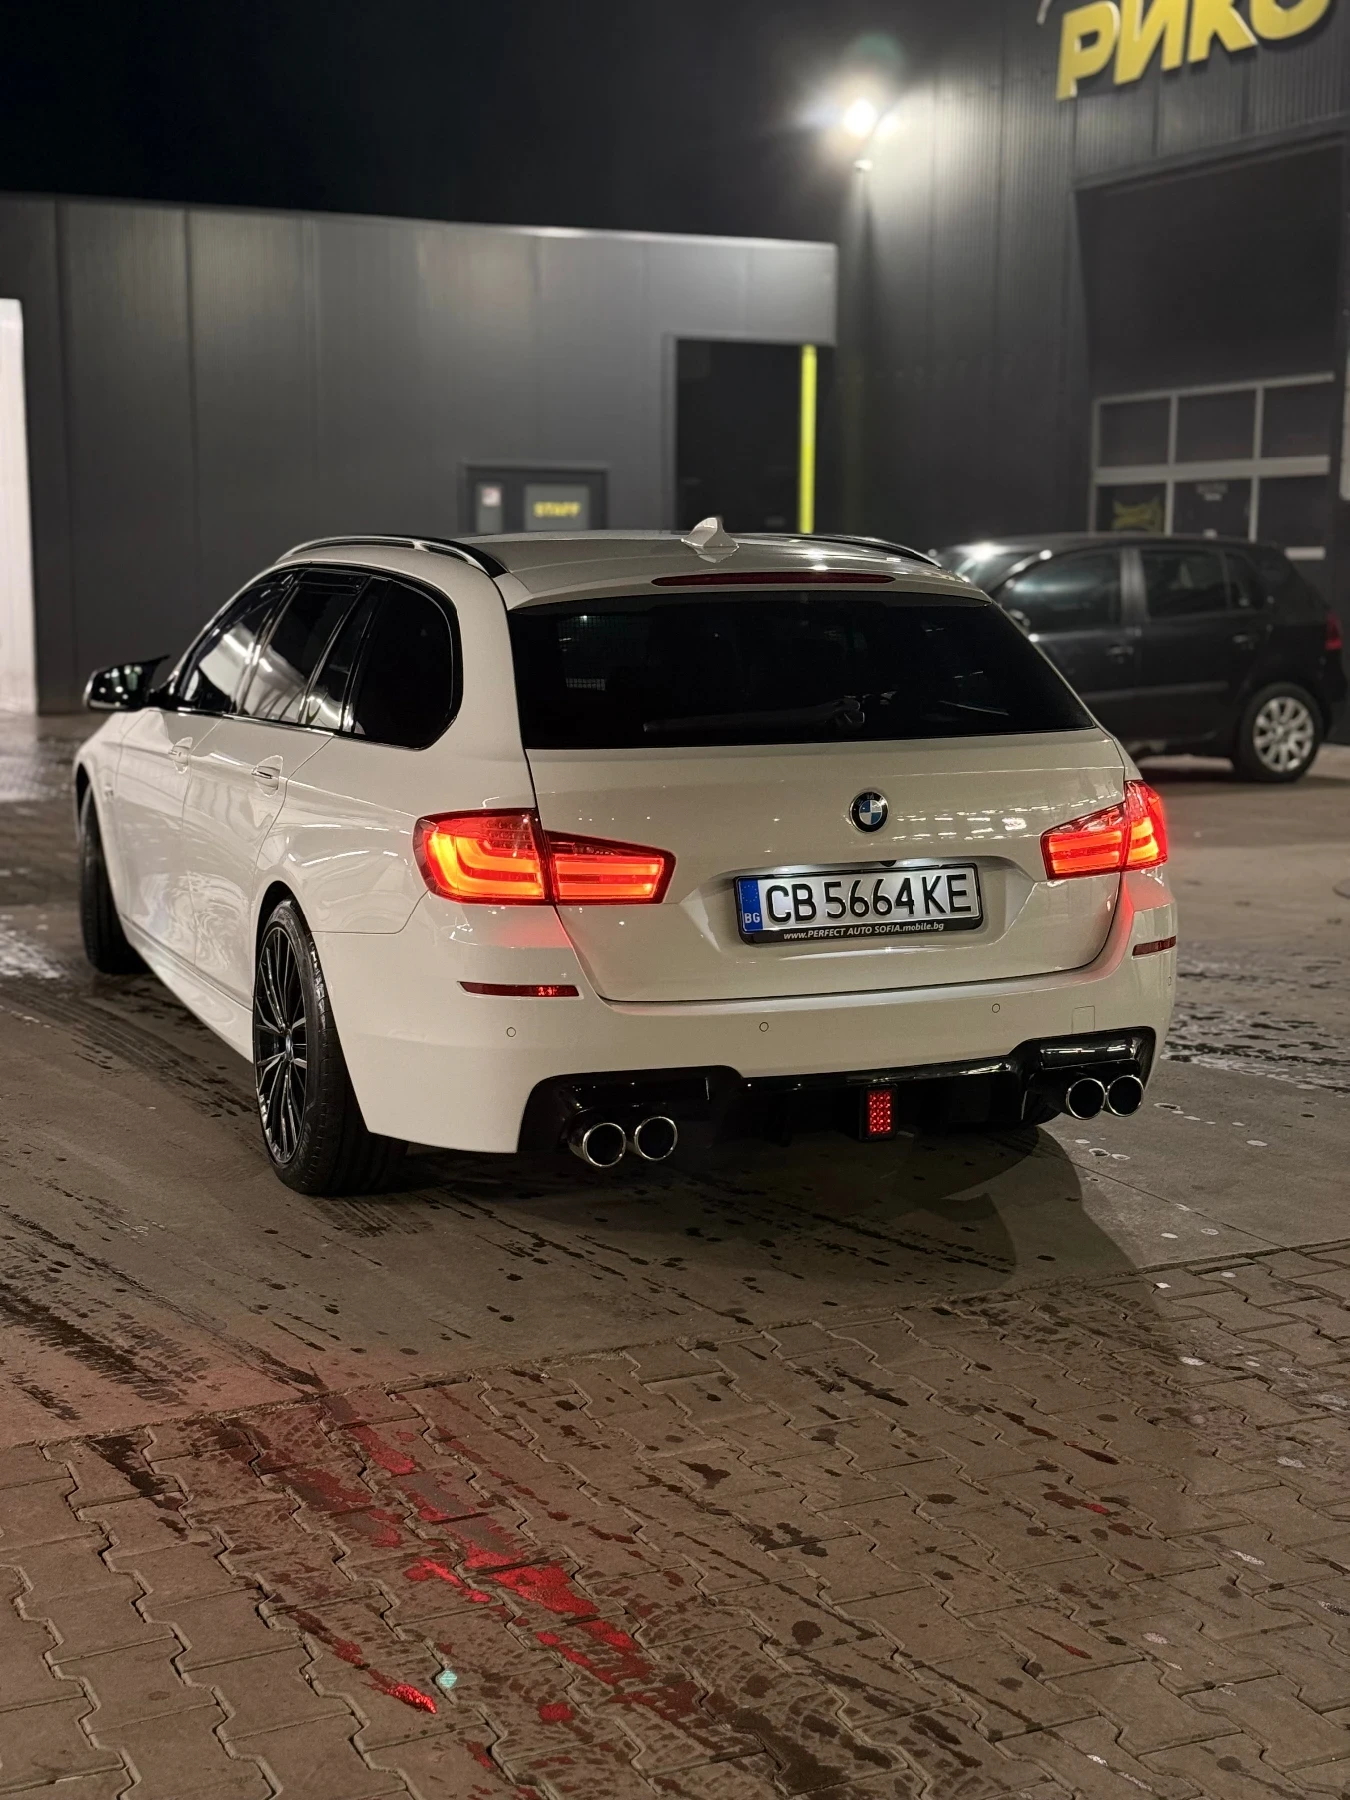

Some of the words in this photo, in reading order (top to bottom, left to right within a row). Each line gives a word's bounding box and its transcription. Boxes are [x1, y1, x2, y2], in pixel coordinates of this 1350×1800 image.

[744, 912, 761, 924] BG
[783, 928, 846, 940] www.PERFECT
[847, 926, 872, 936] AUTO
[874, 921, 945, 934] SOFIA.mobile.bg
